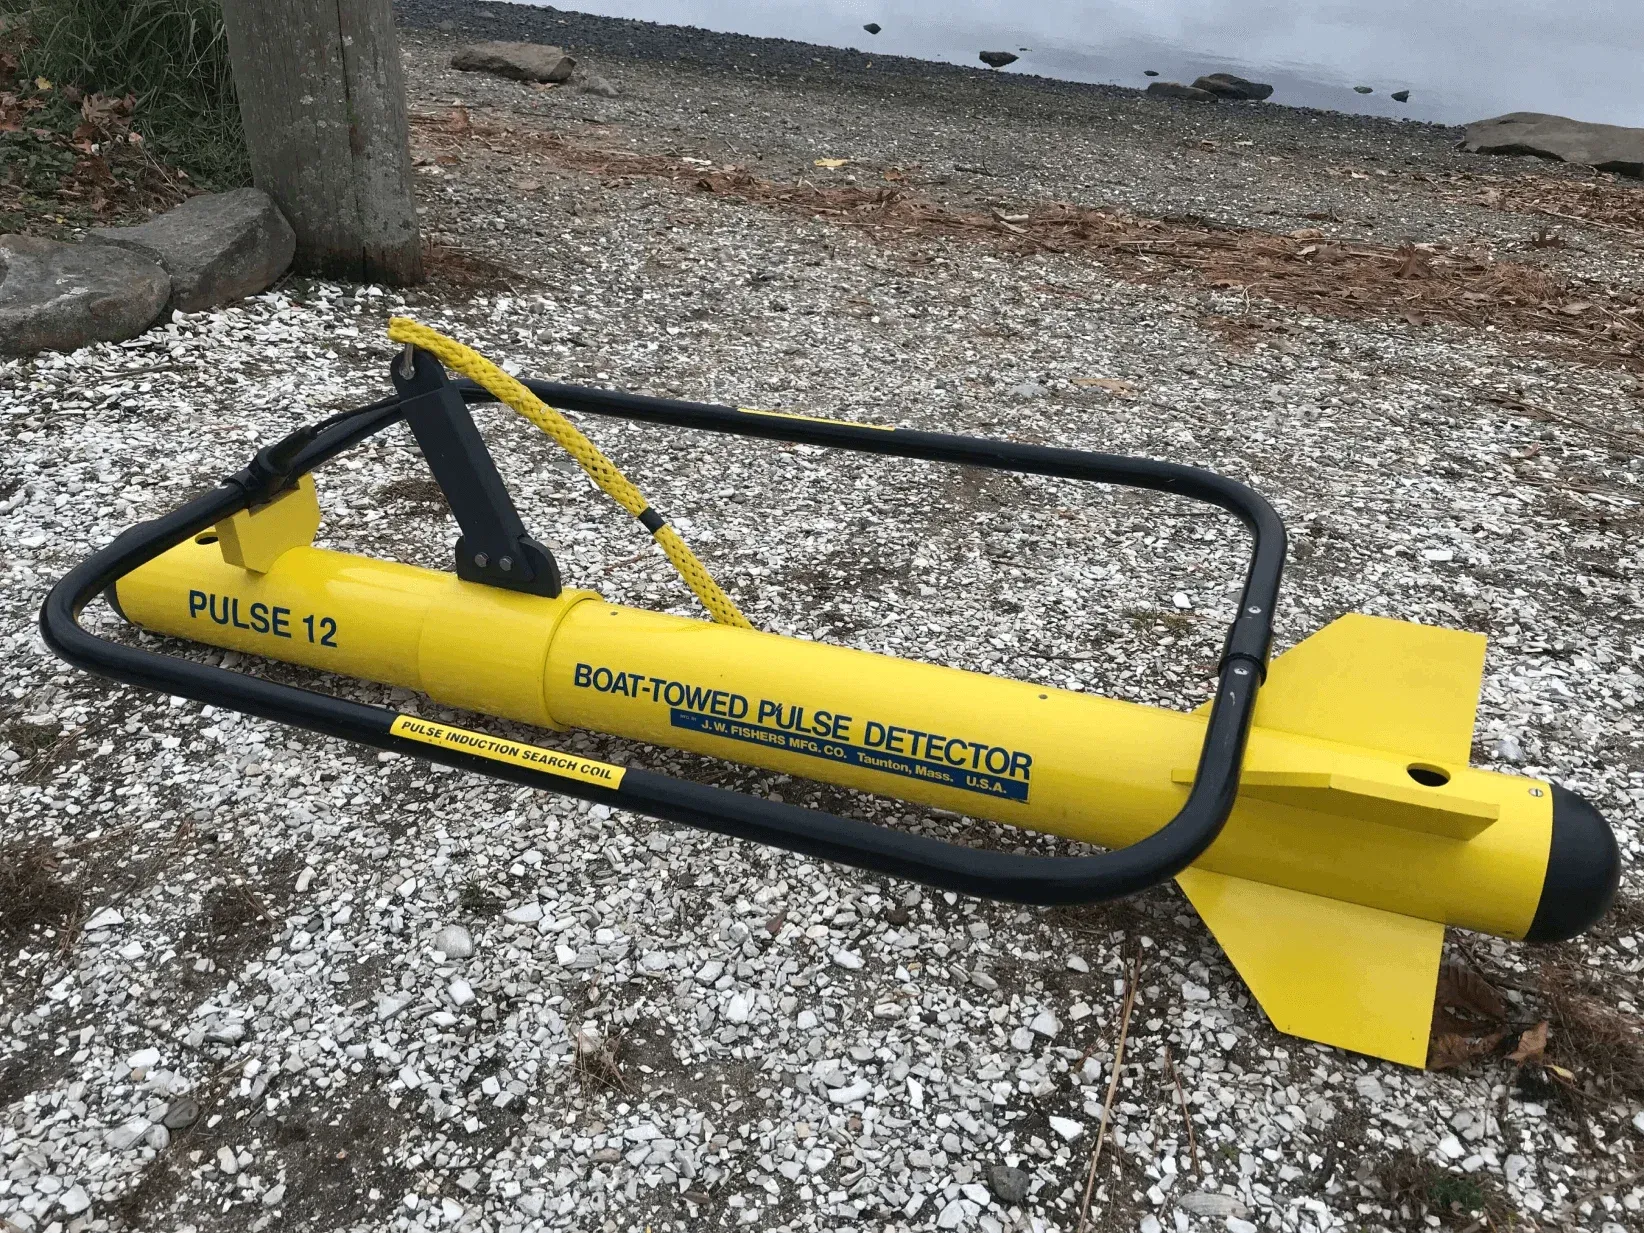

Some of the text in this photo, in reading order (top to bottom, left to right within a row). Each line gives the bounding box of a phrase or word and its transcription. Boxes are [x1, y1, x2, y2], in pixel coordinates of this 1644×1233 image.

[189, 589, 338, 648] PULSE 12
[401, 721, 612, 780] PULSE INDUCTION SEARCH COIL
[574, 663, 1033, 780] BOAT-TOWED PULSE DETECTOR
[701, 719, 712, 731] J.
[714, 722, 728, 734] W.
[731, 724, 786, 746] FISHERS
[789, 734, 821, 753] MFG.
[823, 745, 847, 759] CO.
[857, 751, 912, 775] Taunton,
[915, 764, 954, 783] Mass.
[966, 775, 1007, 794] U.S.A.
